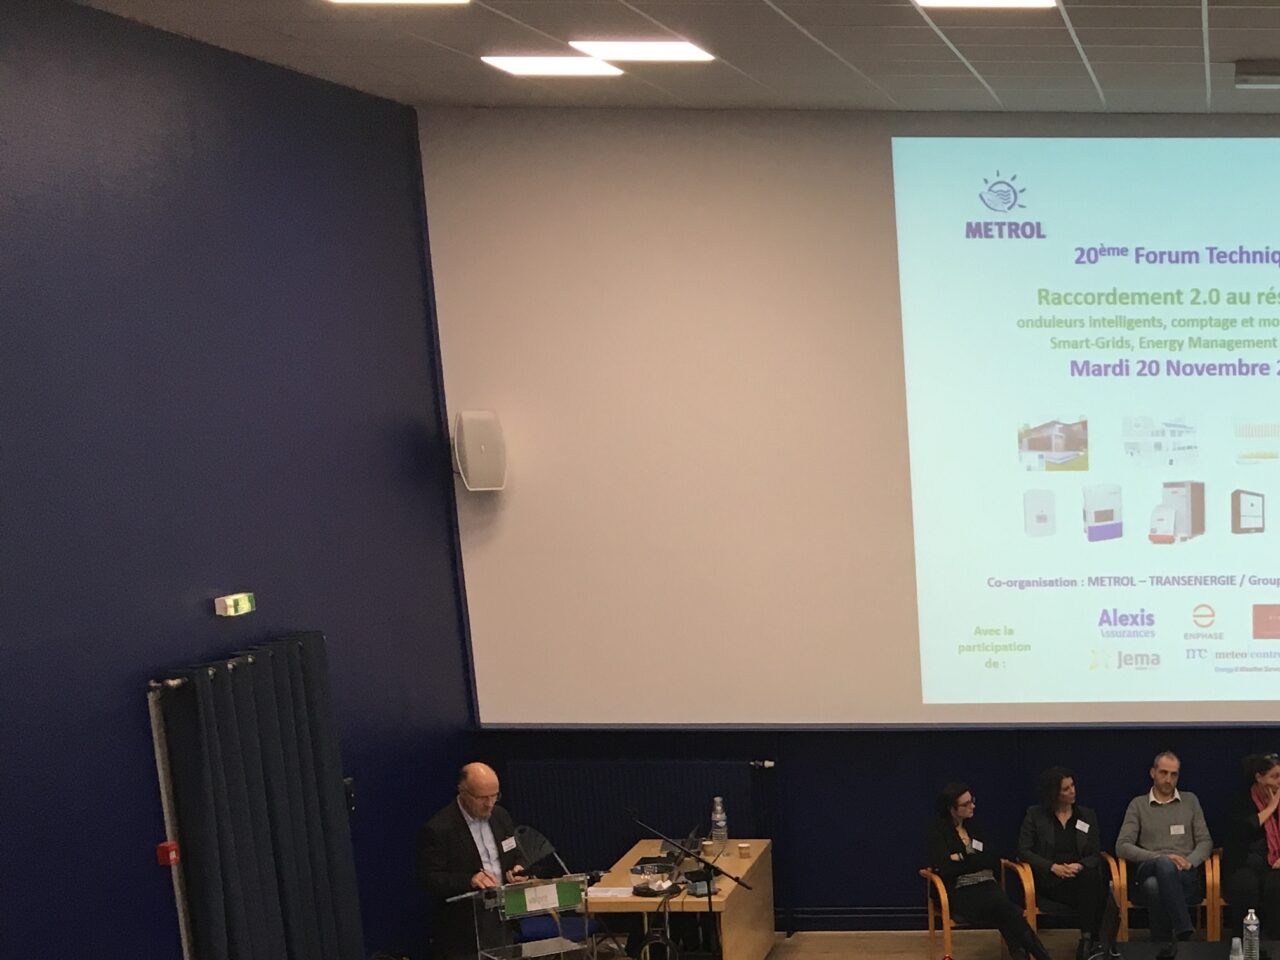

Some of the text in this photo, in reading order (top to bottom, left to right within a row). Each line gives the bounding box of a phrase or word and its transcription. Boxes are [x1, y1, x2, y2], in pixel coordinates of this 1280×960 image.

[965, 221, 1047, 239] METROL
[1074, 243, 1129, 265] 20ème
[1134, 246, 1200, 265] Forum
[1037, 287, 1183, 305] Raccordement
[1190, 288, 1220, 305] 2.0
[1226, 291, 1250, 305] au
[1016, 315, 1085, 329] onduleurs
[1088, 315, 1167, 331] intelligents,
[1171, 316, 1237, 331] comptage
[1241, 316, 1255, 328] et
[1049, 336, 1135, 351] Smart-Grids,
[1138, 337, 1184, 352] Energy
[1188, 336, 1277, 352] Management
[1069, 358, 1130, 377] Mardi
[1136, 359, 1160, 377] 20
[1166, 358, 1271, 377] Novembre
[987, 576, 1078, 590] Co-organisation
[1087, 576, 1136, 587] METROL
[1148, 575, 1237, 587] TRANSENERGIE
[1098, 608, 1155, 627] Alexis
[973, 625, 1014, 636] Avec la
[1183, 632, 1224, 640] ENPHASE
[958, 641, 1031, 655] participation
[985, 658, 1000, 669] de
[1116, 650, 1161, 669] Jema
